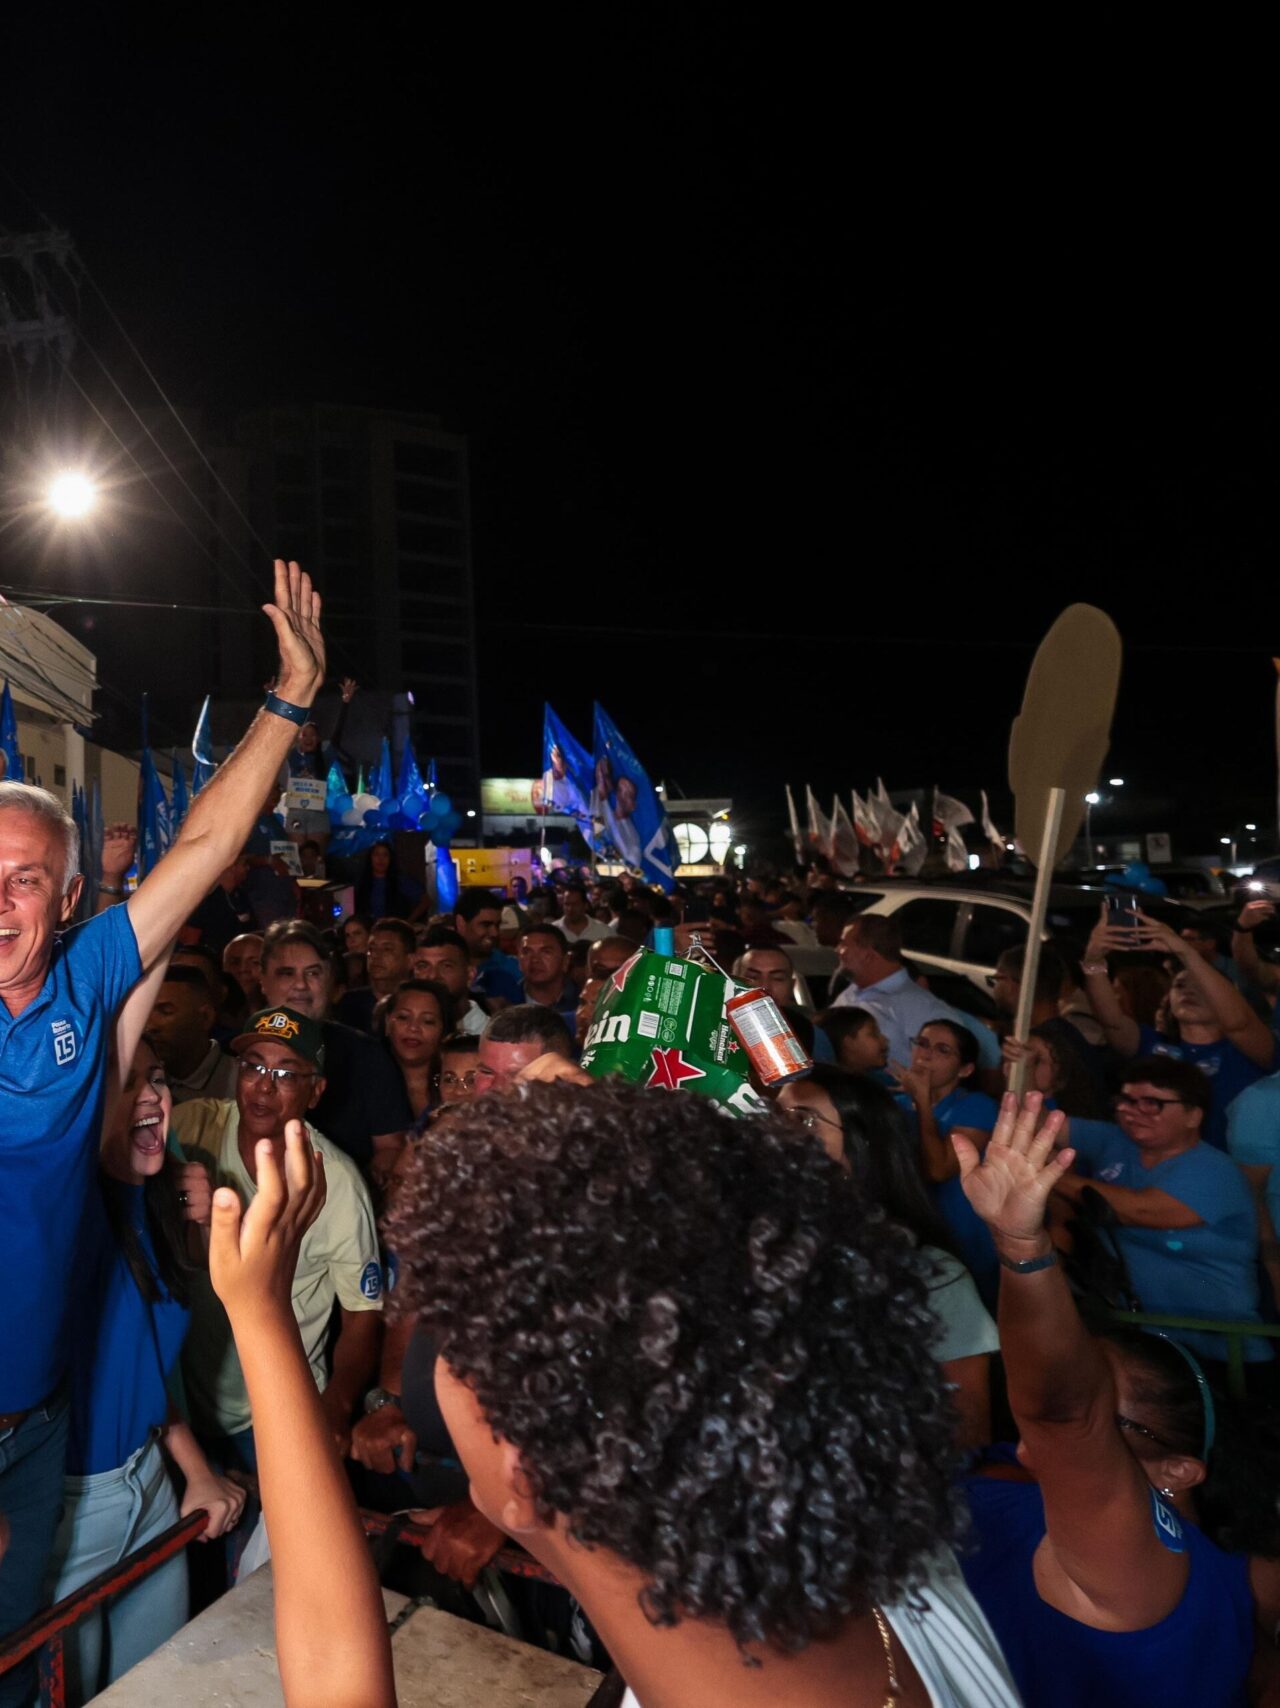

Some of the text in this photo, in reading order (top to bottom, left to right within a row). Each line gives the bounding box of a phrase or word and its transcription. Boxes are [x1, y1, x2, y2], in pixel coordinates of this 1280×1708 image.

[269, 1015, 287, 1028] JB
[584, 1009, 632, 1050] ein
[57, 1036, 74, 1061] 15
[716, 1024, 729, 1061] Heineken
